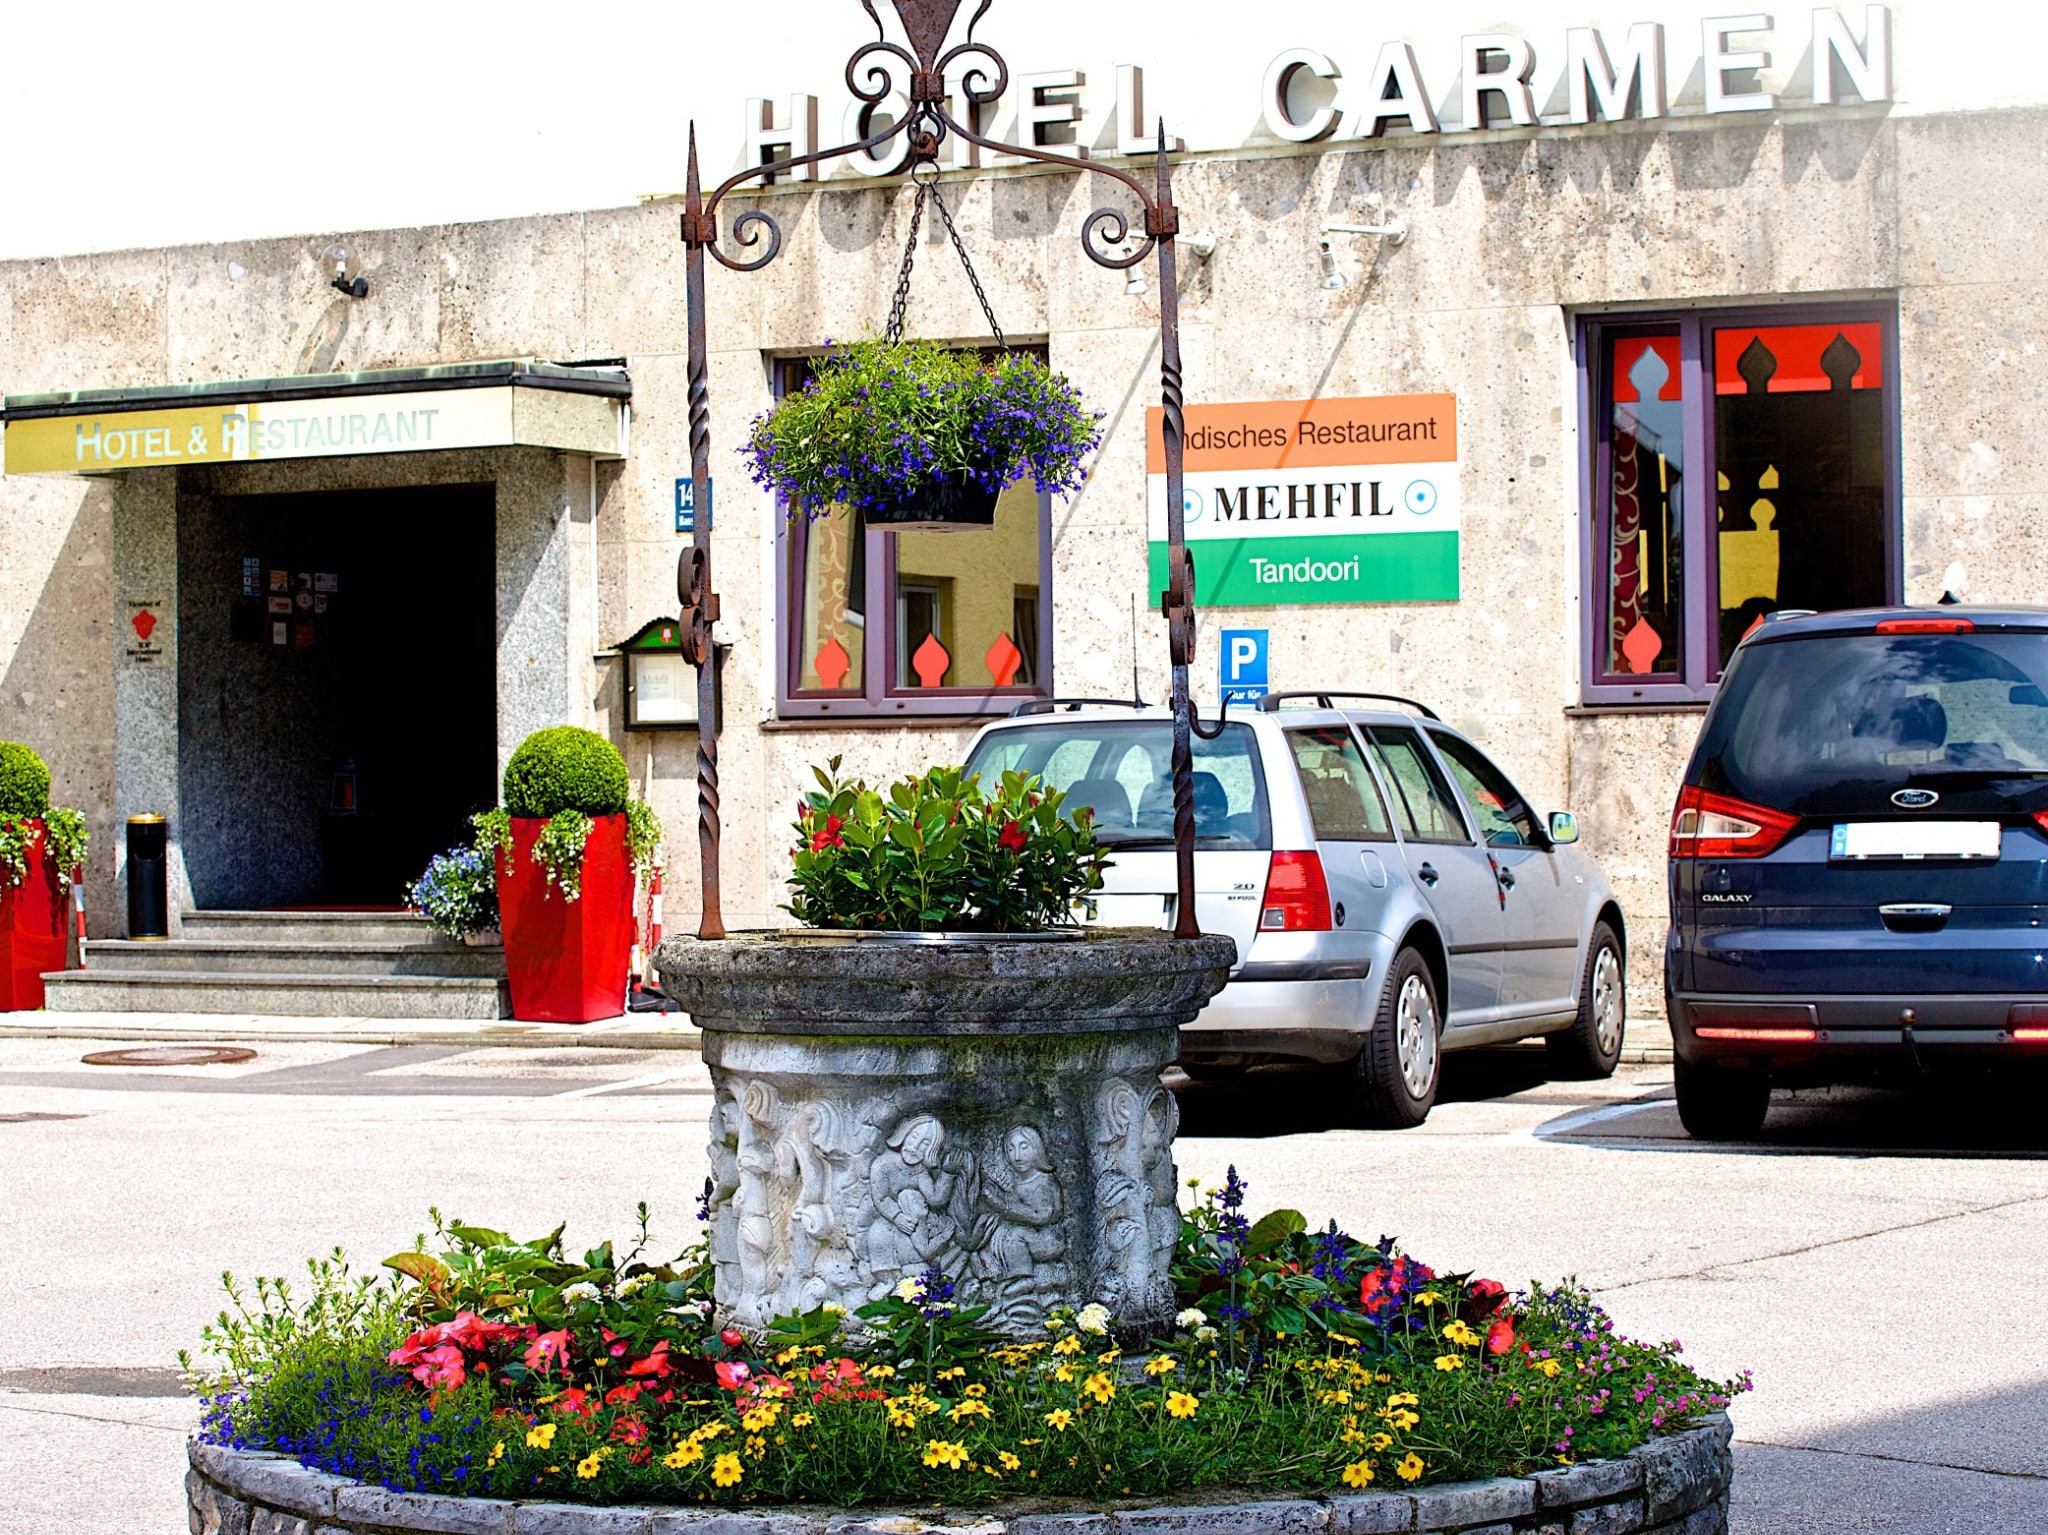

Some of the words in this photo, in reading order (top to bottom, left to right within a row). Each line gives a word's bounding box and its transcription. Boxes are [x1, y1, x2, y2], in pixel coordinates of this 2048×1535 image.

[745, 63, 1185, 186] HOTEL
[1261, 3, 1893, 142] CARMEN
[76, 422, 182, 462] HOTEL
[187, 424, 208, 456] &
[221, 409, 439, 454] RESTAURANT
[1183, 424, 1287, 450] ndisches
[1298, 417, 1438, 446] Restaurant
[678, 483, 694, 507] 14
[1213, 481, 1395, 522] MEHFIL
[1249, 555, 1360, 584] Tandoori
[1231, 637, 1258, 680] P
[1702, 894, 1753, 903] GALAXY
